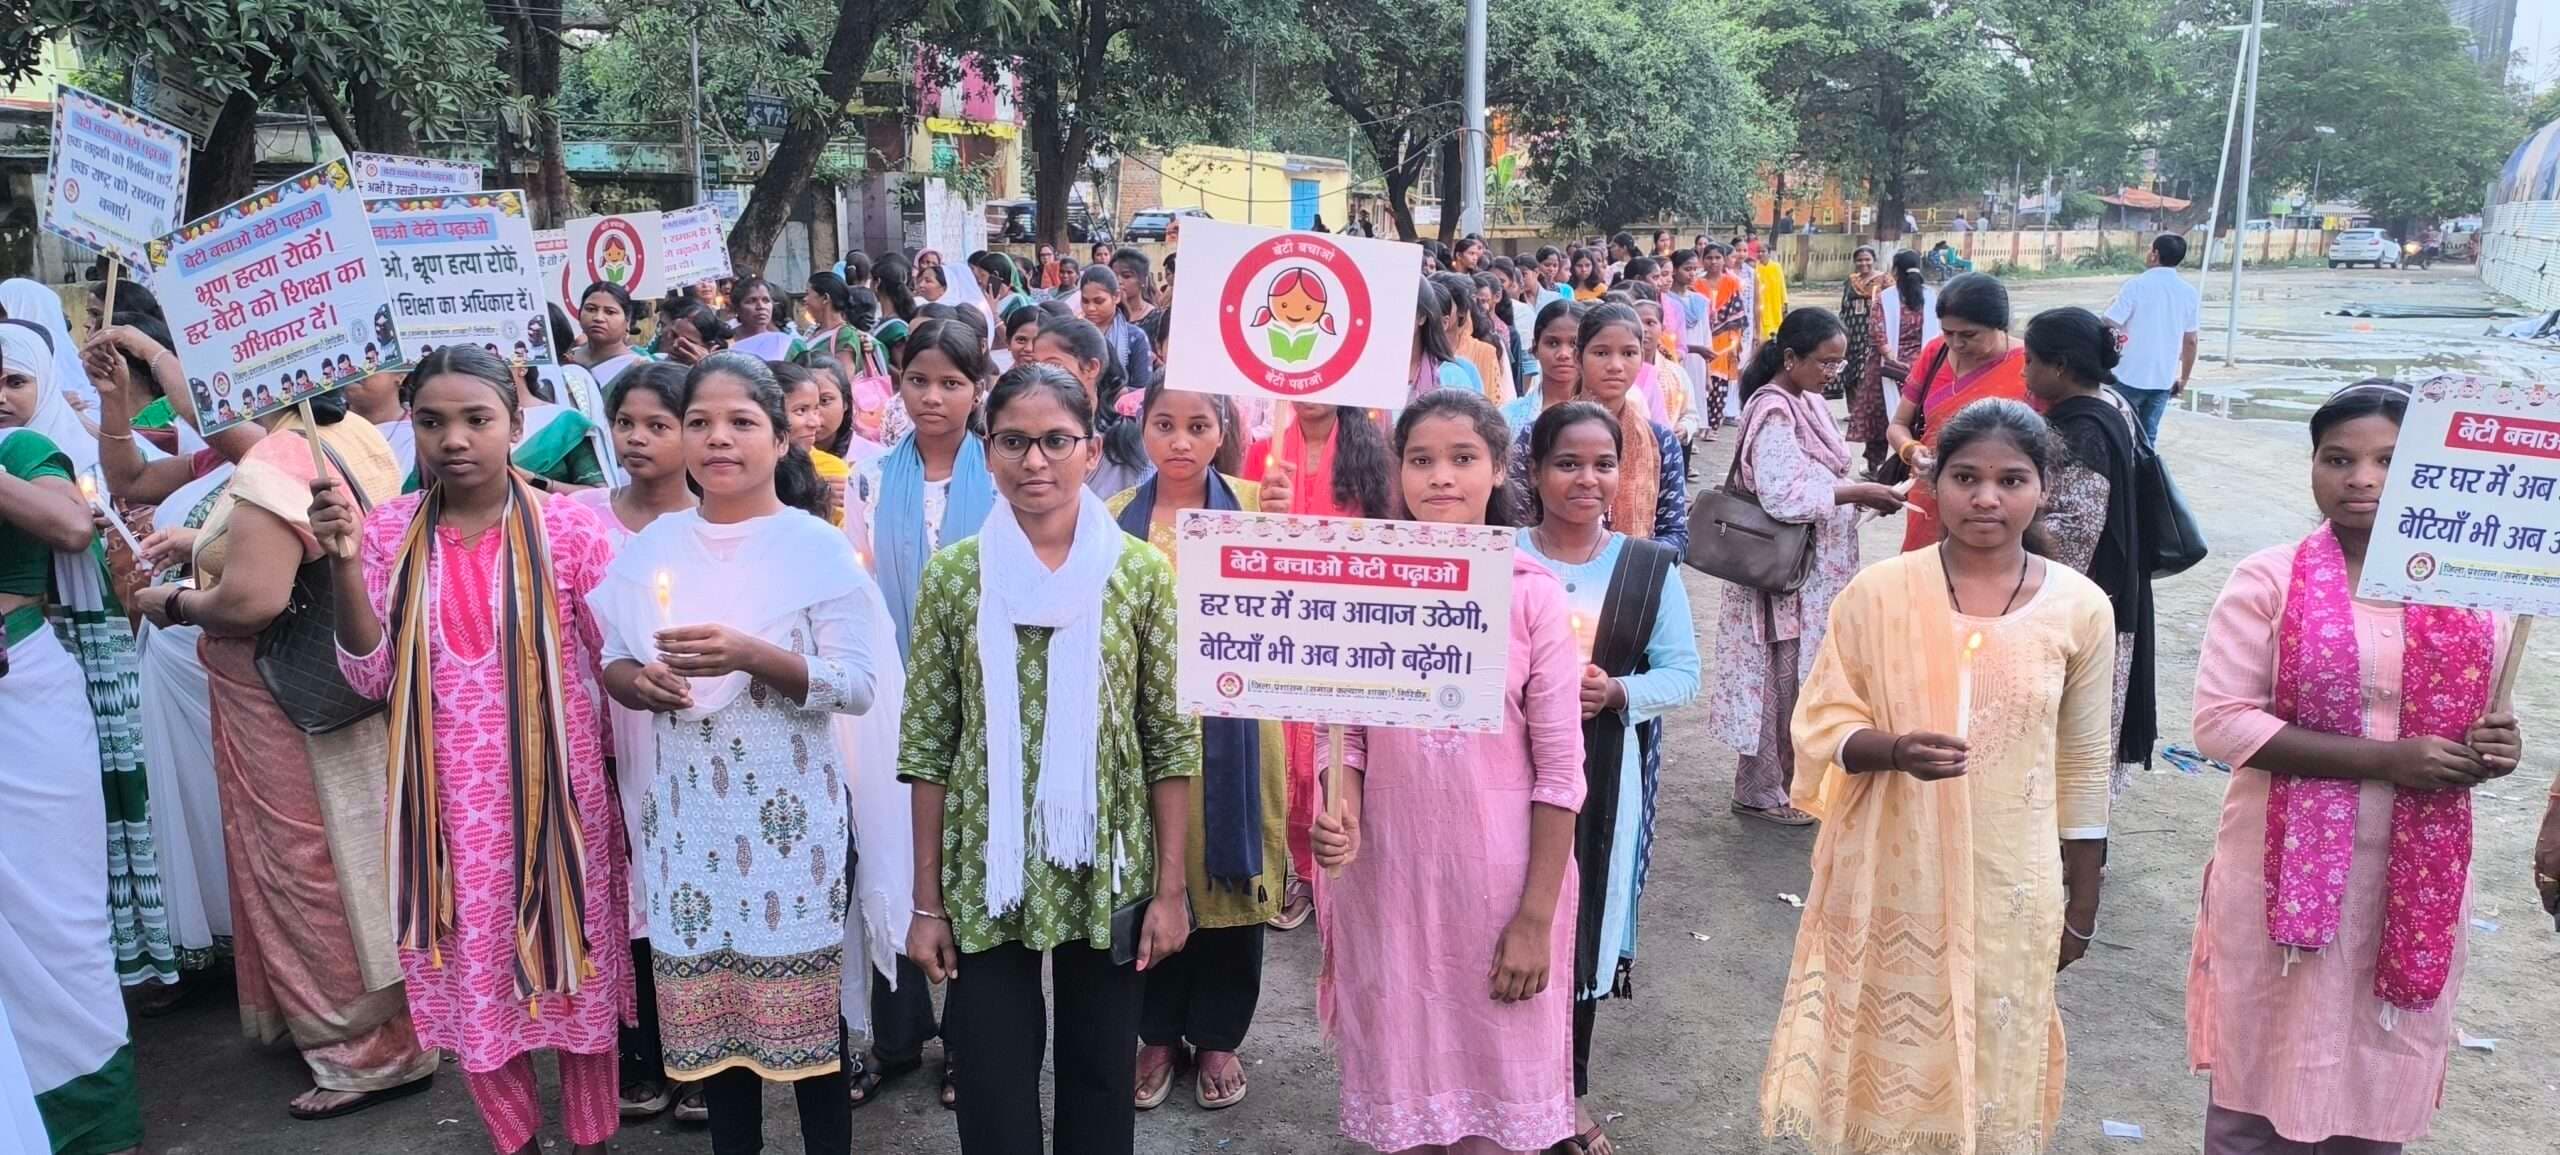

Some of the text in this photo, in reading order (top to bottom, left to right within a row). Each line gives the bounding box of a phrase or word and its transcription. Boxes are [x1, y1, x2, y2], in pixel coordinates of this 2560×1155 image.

[66, 132, 82, 148] एक
[112, 150, 125, 167] को
[746, 150, 760, 162] 20
[70, 158, 90, 178] एक
[91, 165, 112, 191] राष्ट्र
[113, 173, 129, 195] को
[368, 180, 385, 194] अभी
[387, 181, 394, 195] है
[183, 199, 324, 270] बेटी बचाओ बेटी पढ़ाओ
[372, 216, 490, 240] चाओ बेटी पढ़ाओ
[195, 227, 335, 309] भ्रूण हत्या रोकें।
[411, 254, 444, 286] भ्रूण
[445, 252, 483, 276] हत्या
[484, 245, 525, 277] रोकें,
[1272, 238, 1336, 264] बेटी बचाओ
[184, 256, 367, 346] हर बेटी को शिक्षा का
[398, 292, 436, 317] शिक्षा
[436, 296, 457, 314] का
[460, 289, 515, 314] अधिकार
[231, 316, 308, 364] अधिकार
[1264, 368, 1286, 388] बेटी
[2458, 416, 2501, 444] बेटी
[2410, 463, 2557, 502] हर घर में अब
[2398, 506, 2471, 544] बेटियाँ
[2469, 514, 2502, 548] भी
[2504, 526, 2547, 553] अब
[1230, 550, 1460, 588] बेटी बचाओ बेटी पढ़ाओ
[1200, 590, 1490, 634] हर घर में अब आवाज उठेगी,
[1200, 631, 1473, 680] बेटियाँ भी अब आगे बढ़ेंगी।
